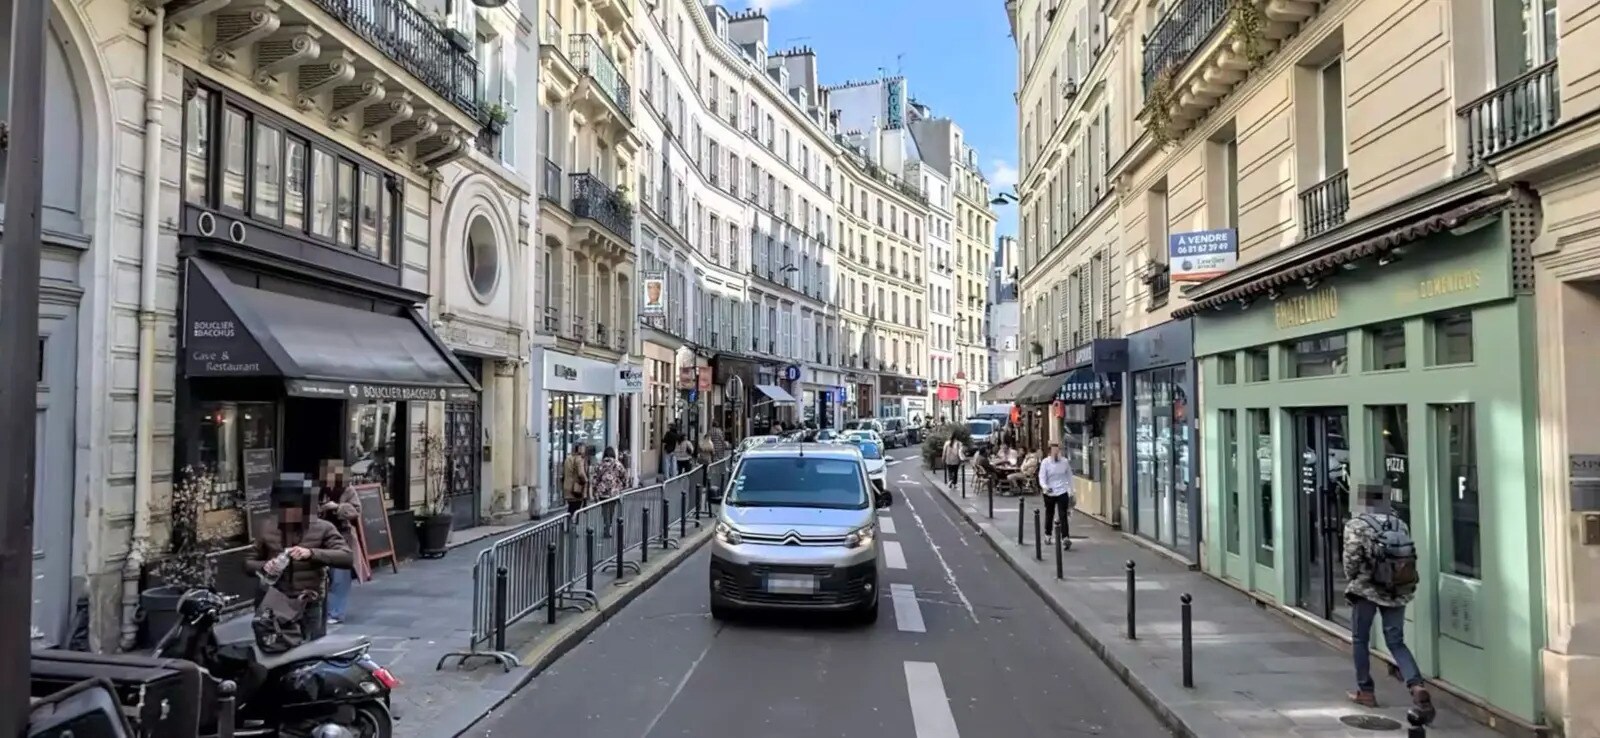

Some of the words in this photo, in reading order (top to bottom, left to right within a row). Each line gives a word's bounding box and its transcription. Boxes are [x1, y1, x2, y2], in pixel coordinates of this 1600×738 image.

[1188, 233, 1228, 244] VENDRE
[1177, 246, 1187, 254] 06
[1188, 245, 1197, 253] 81
[194, 321, 235, 330] BOUCLIER
[198, 329, 235, 337] BACCHUS
[193, 351, 217, 361] Cave
[221, 351, 229, 360] &
[206, 362, 260, 372] Restaurant
[363, 385, 401, 399] BOUCLIER
[406, 388, 436, 400] BACCHUS
[1385, 457, 1405, 473] PIZZA
[1458, 476, 1467, 500] F
